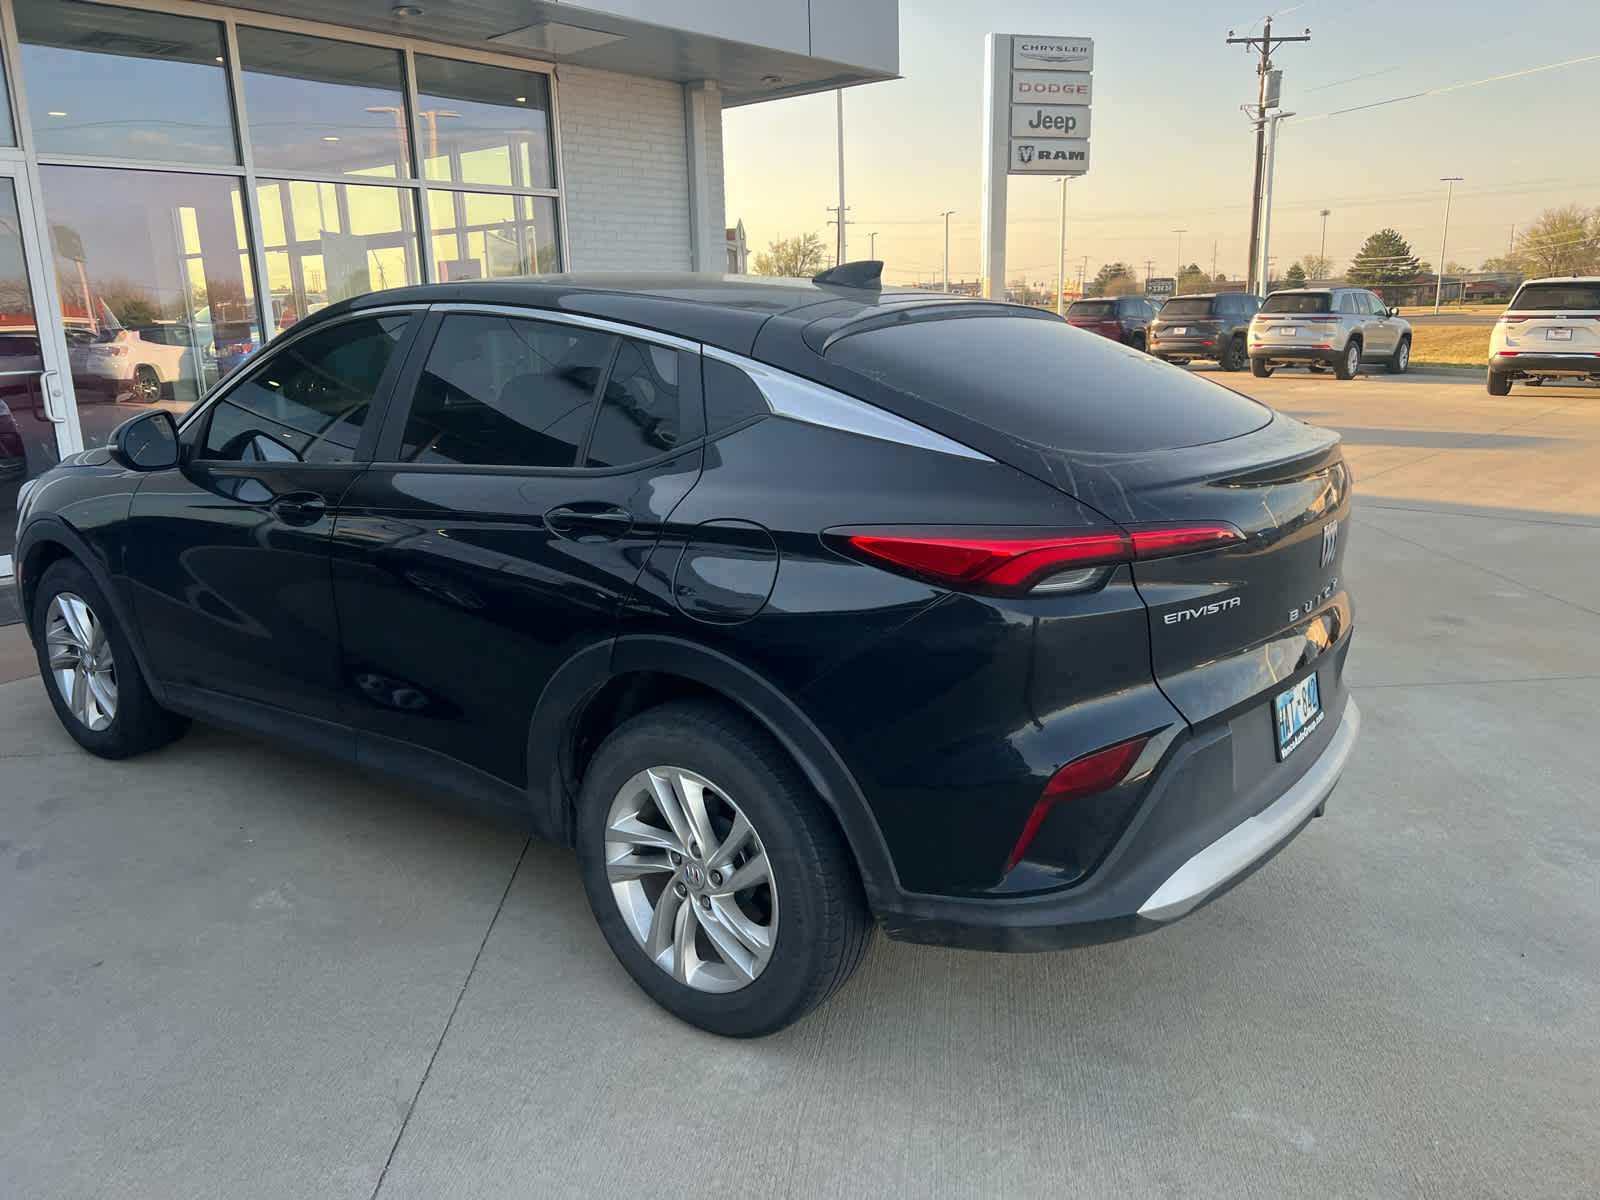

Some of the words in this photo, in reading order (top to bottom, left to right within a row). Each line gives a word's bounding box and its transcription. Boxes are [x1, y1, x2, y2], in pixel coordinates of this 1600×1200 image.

[1021, 44, 1087, 53] CHRYSLER
[1018, 82, 1088, 95] DODGE
[1028, 110, 1076, 134] Jeep
[1038, 150, 1085, 161] RAM
[1163, 596, 1240, 625] ENVISTA
